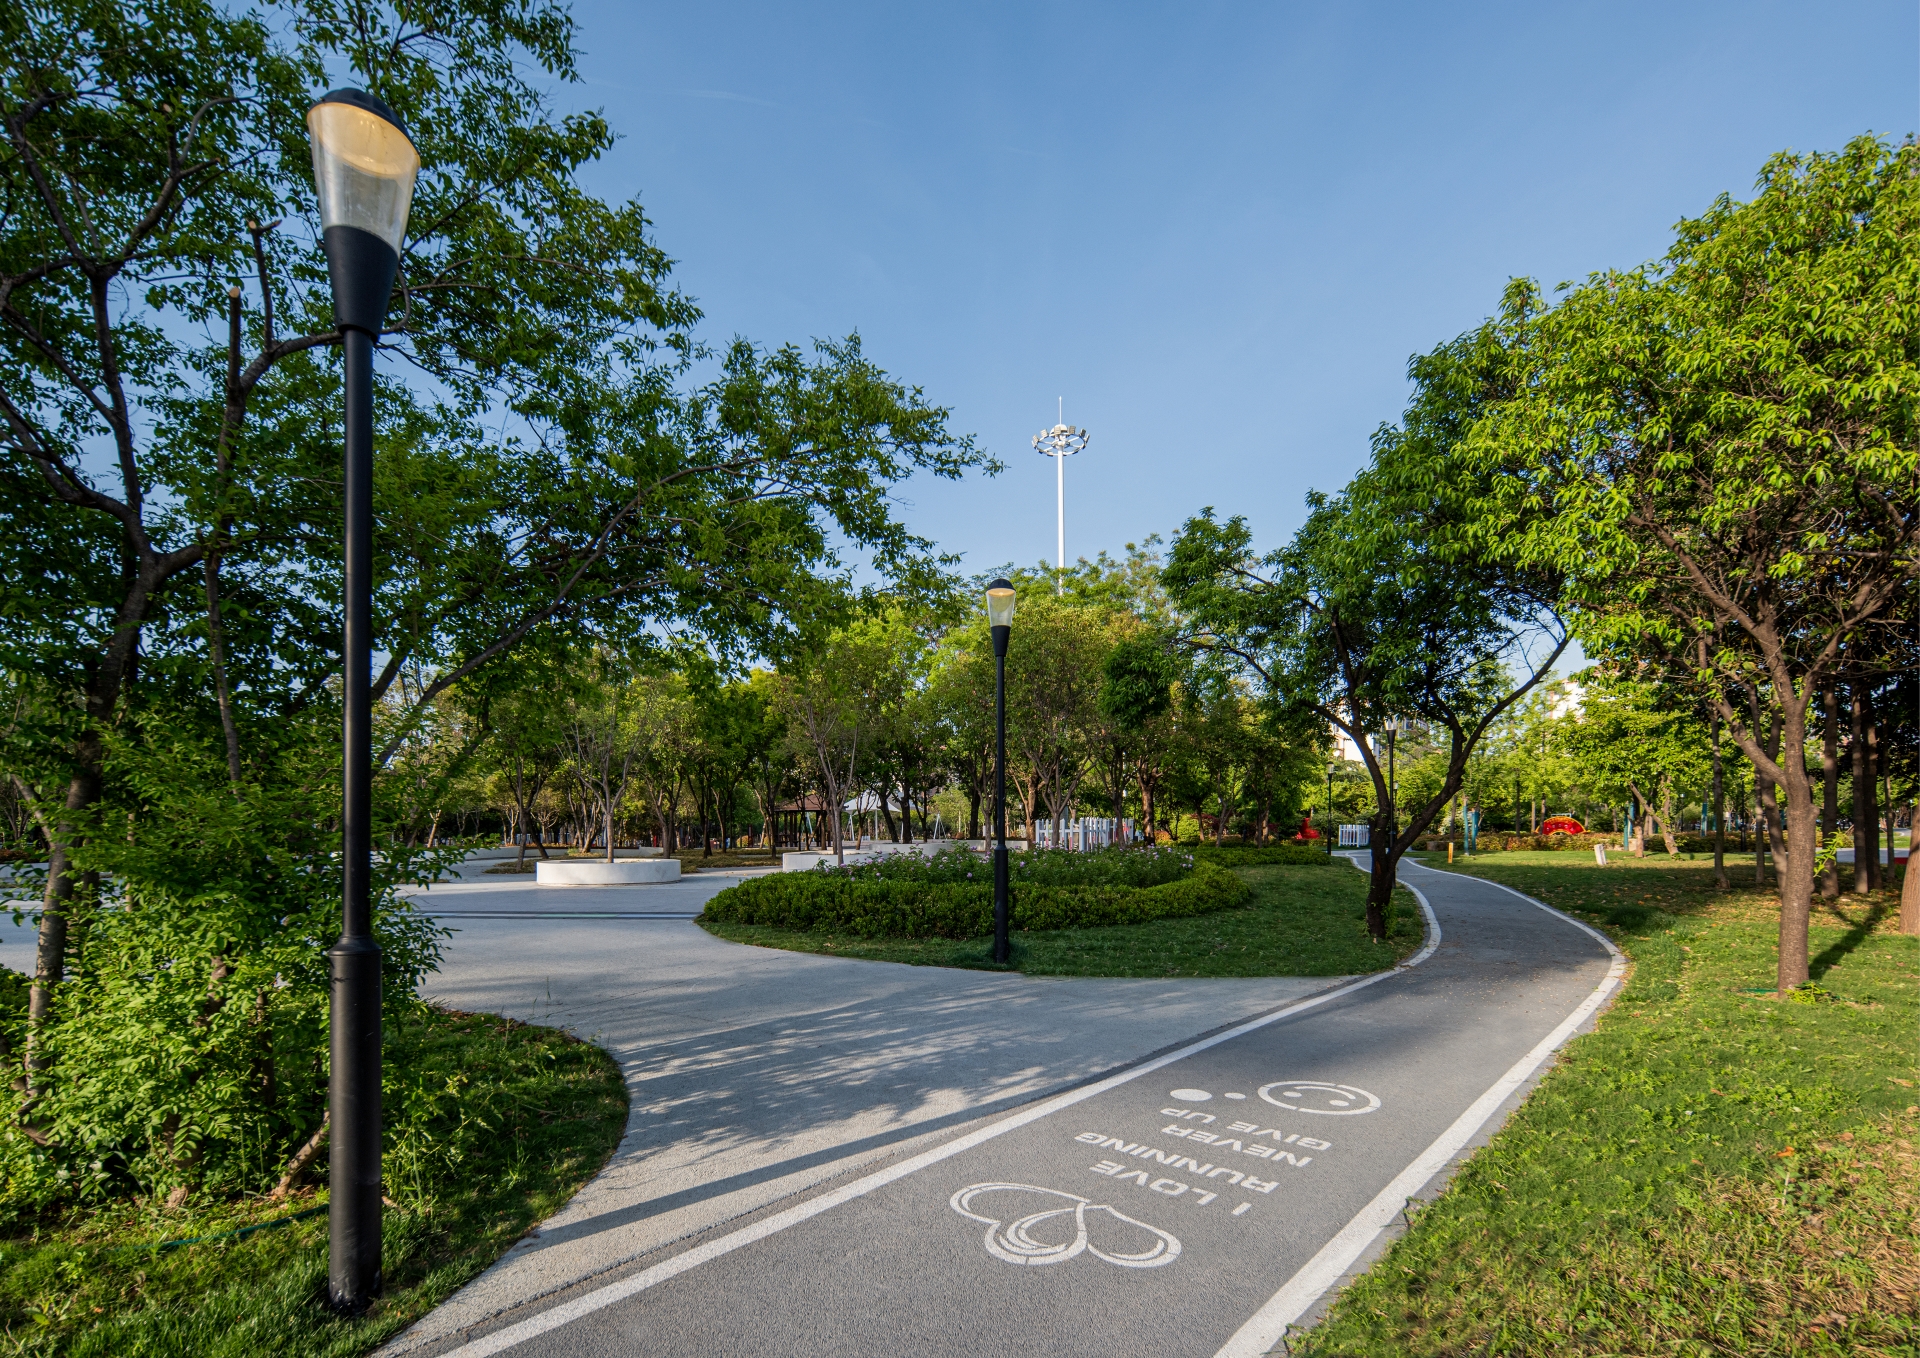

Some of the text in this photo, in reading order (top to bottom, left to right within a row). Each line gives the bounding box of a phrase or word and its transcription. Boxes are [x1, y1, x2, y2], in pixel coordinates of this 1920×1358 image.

[1160, 1107, 1332, 1151] GIVE UP
[1161, 1124, 1312, 1167] NEVER
[1074, 1132, 1279, 1194] RUNNING
[1089, 1159, 1252, 1216] I LOVE
